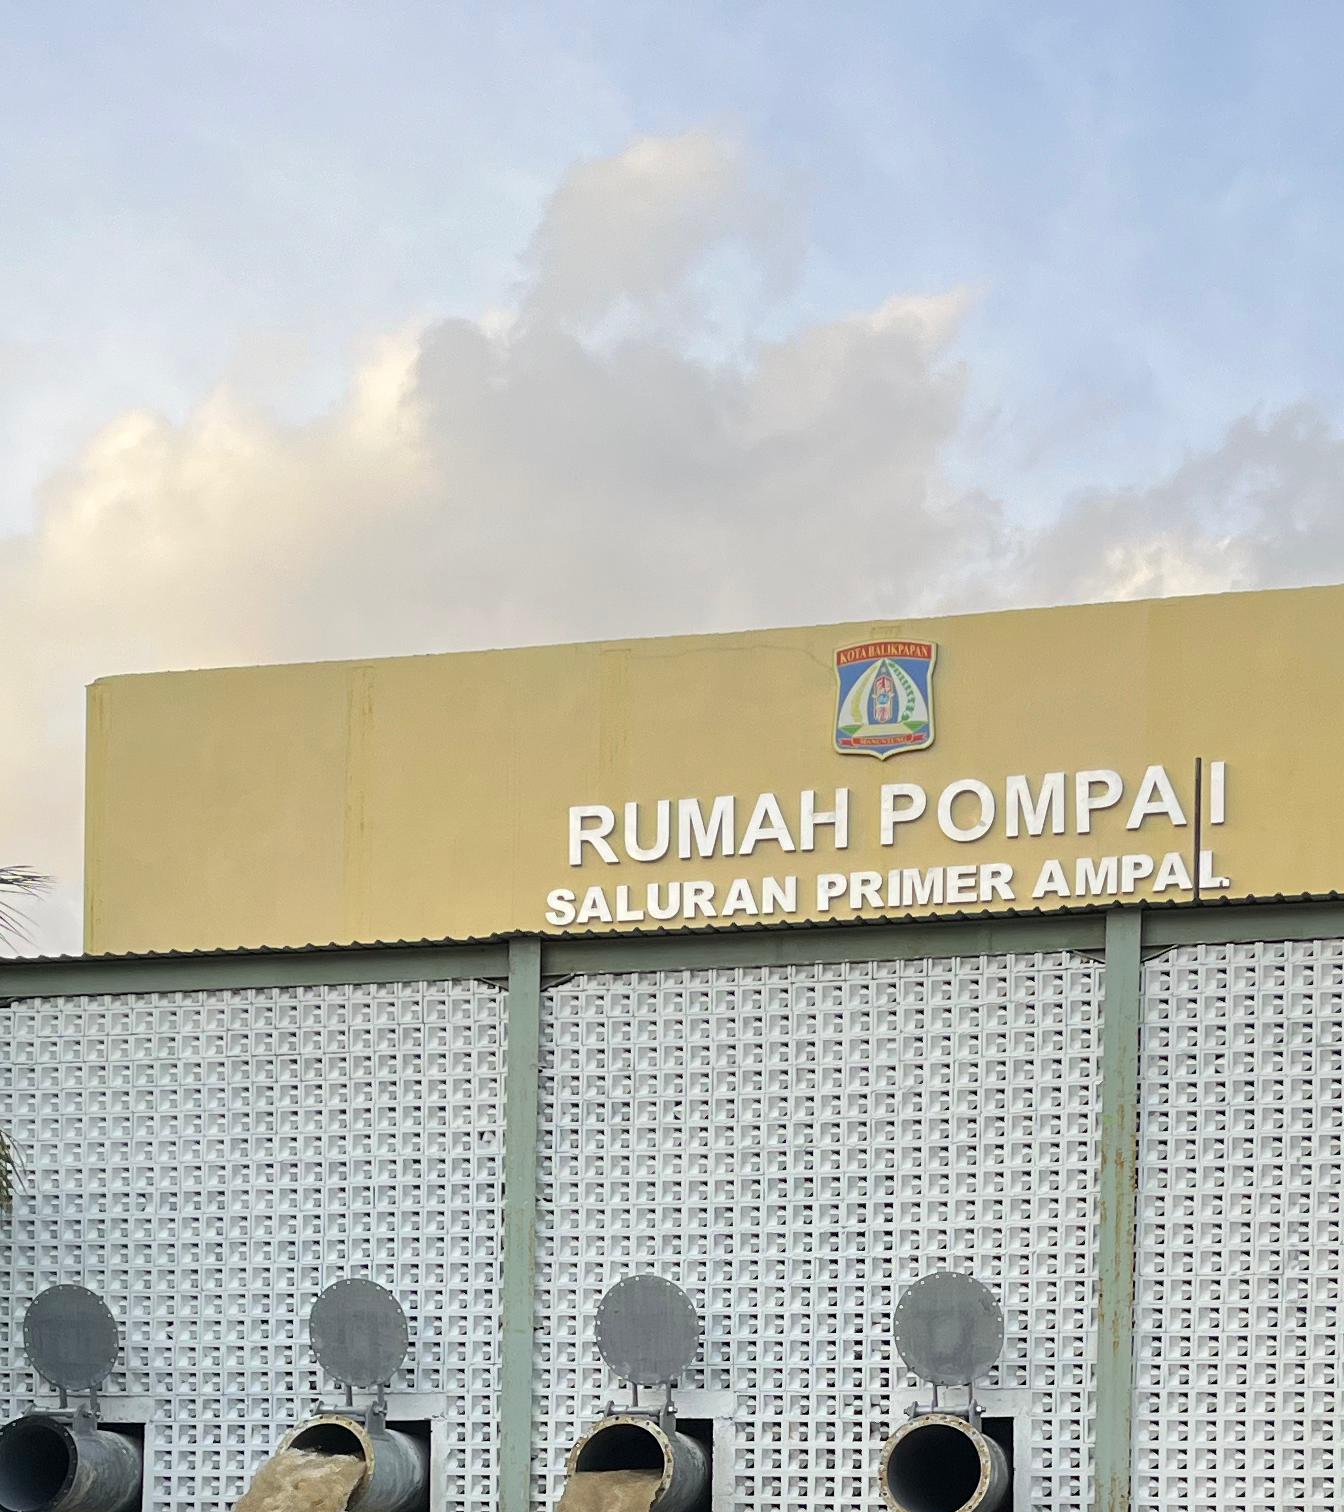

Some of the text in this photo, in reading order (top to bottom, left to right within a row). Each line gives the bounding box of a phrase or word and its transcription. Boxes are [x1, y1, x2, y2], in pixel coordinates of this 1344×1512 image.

[840, 643, 929, 664] KOTA BALIKPAPAN
[569, 761, 1225, 866] RUMAH POMPA I
[545, 850, 1229, 926] SALURAN PRIMER AMPAL
